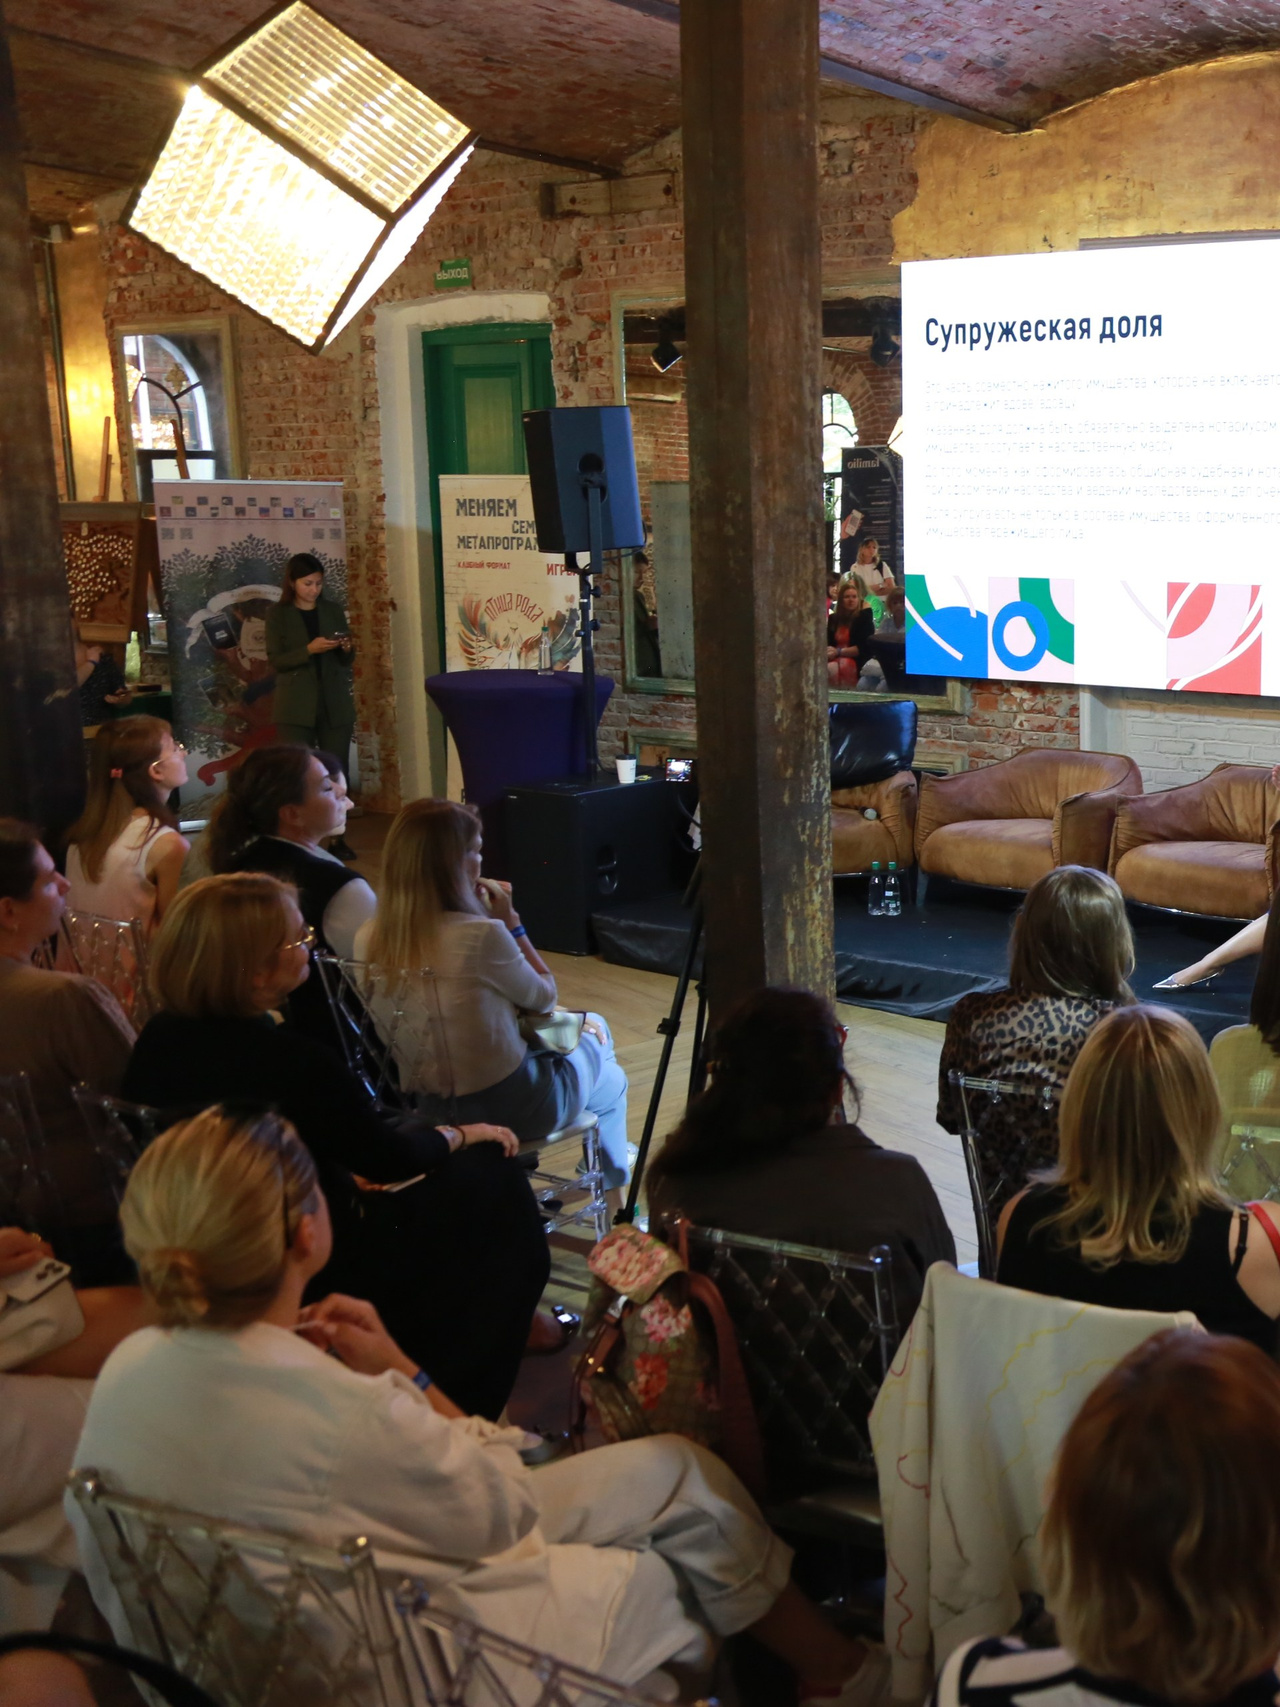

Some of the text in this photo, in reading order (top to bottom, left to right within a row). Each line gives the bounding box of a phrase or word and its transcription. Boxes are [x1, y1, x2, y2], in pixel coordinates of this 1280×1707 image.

[925, 314, 1162, 352] Супружеская доля
[1203, 375, 1215, 386] не
[1149, 420, 1205, 433] выделена
[1209, 419, 1277, 435] нотариусом
[1247, 466, 1254, 477] и
[1077, 486, 1083, 496] и
[1231, 486, 1252, 498] дел
[456, 499, 517, 516] МЕНЯЕМ
[512, 521, 536, 534] СЕМ
[457, 561, 484, 569] КЛУБНЫЙ
